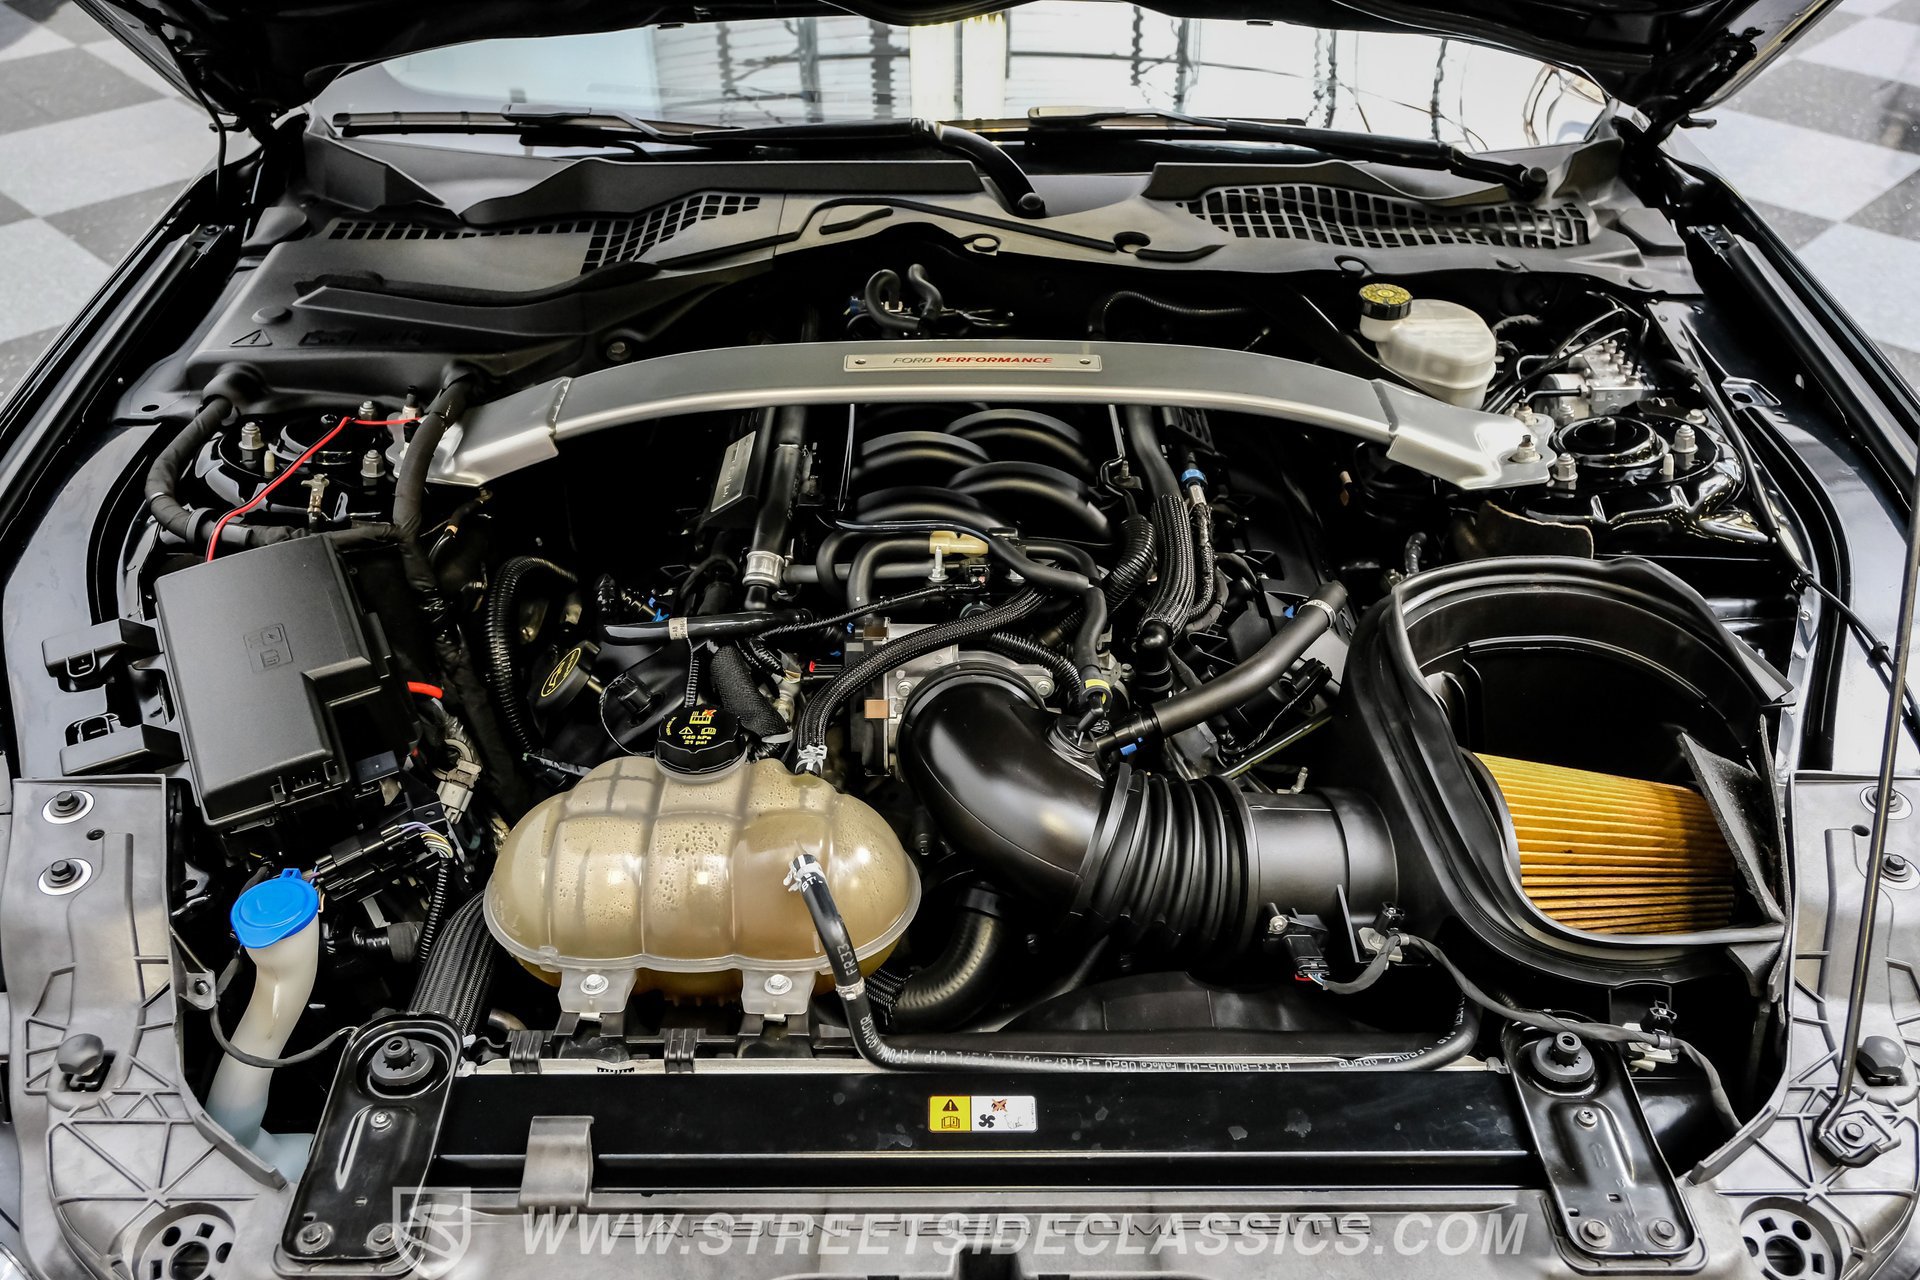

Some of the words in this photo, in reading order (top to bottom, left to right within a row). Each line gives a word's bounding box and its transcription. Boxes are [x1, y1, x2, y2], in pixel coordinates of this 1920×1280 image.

[935, 356, 1053, 364] PERFORMANCE
[838, 942, 858, 977] FR33
[1104, 1060, 1137, 1072] 0620
